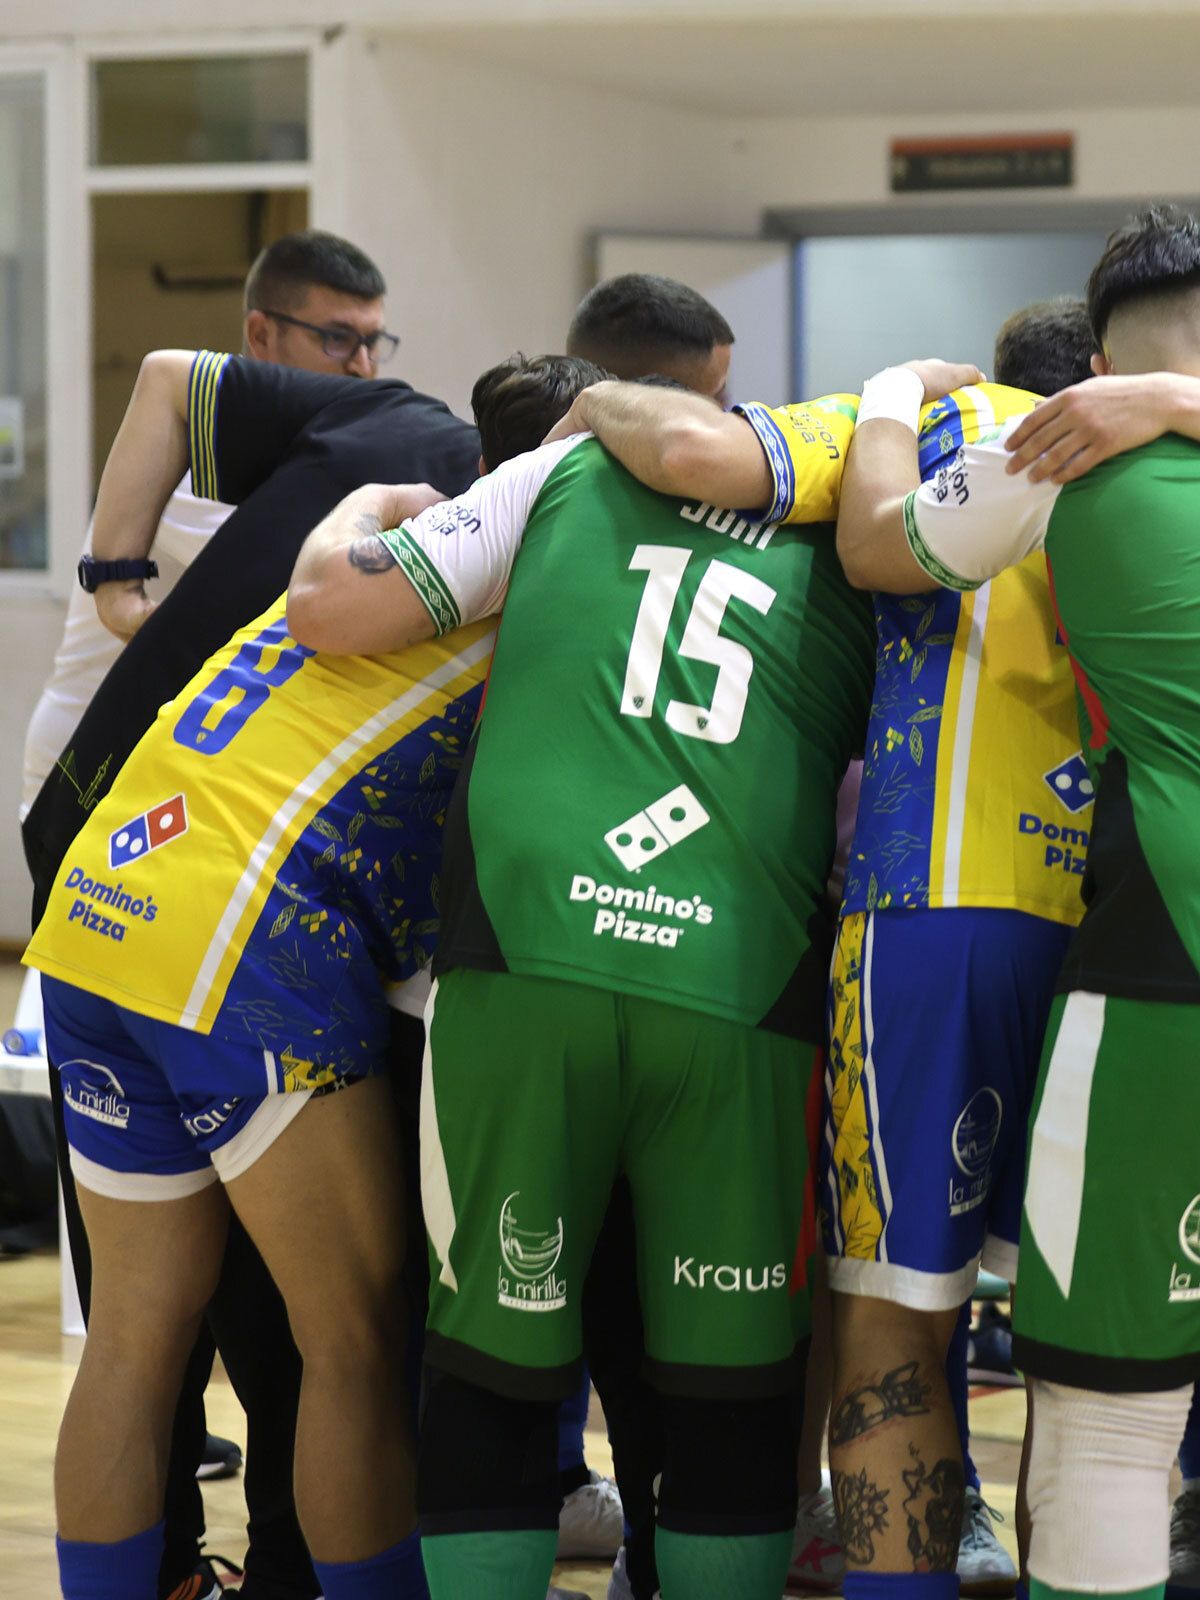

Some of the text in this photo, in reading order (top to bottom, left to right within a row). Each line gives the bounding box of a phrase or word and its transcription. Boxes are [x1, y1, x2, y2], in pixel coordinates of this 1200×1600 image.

[620, 544, 778, 745] 15
[1044, 844, 1088, 876] Piz
[64, 866, 159, 922] Domino's
[569, 874, 714, 925] Domino's
[67, 898, 126, 942] Pizza
[593, 908, 680, 948] Pizza
[79, 1090, 131, 1120] mirilla
[949, 1178, 965, 1205] la
[498, 1265, 567, 1301] la mirilla
[673, 1256, 787, 1293] Kraus
[1168, 1262, 1192, 1291] la
